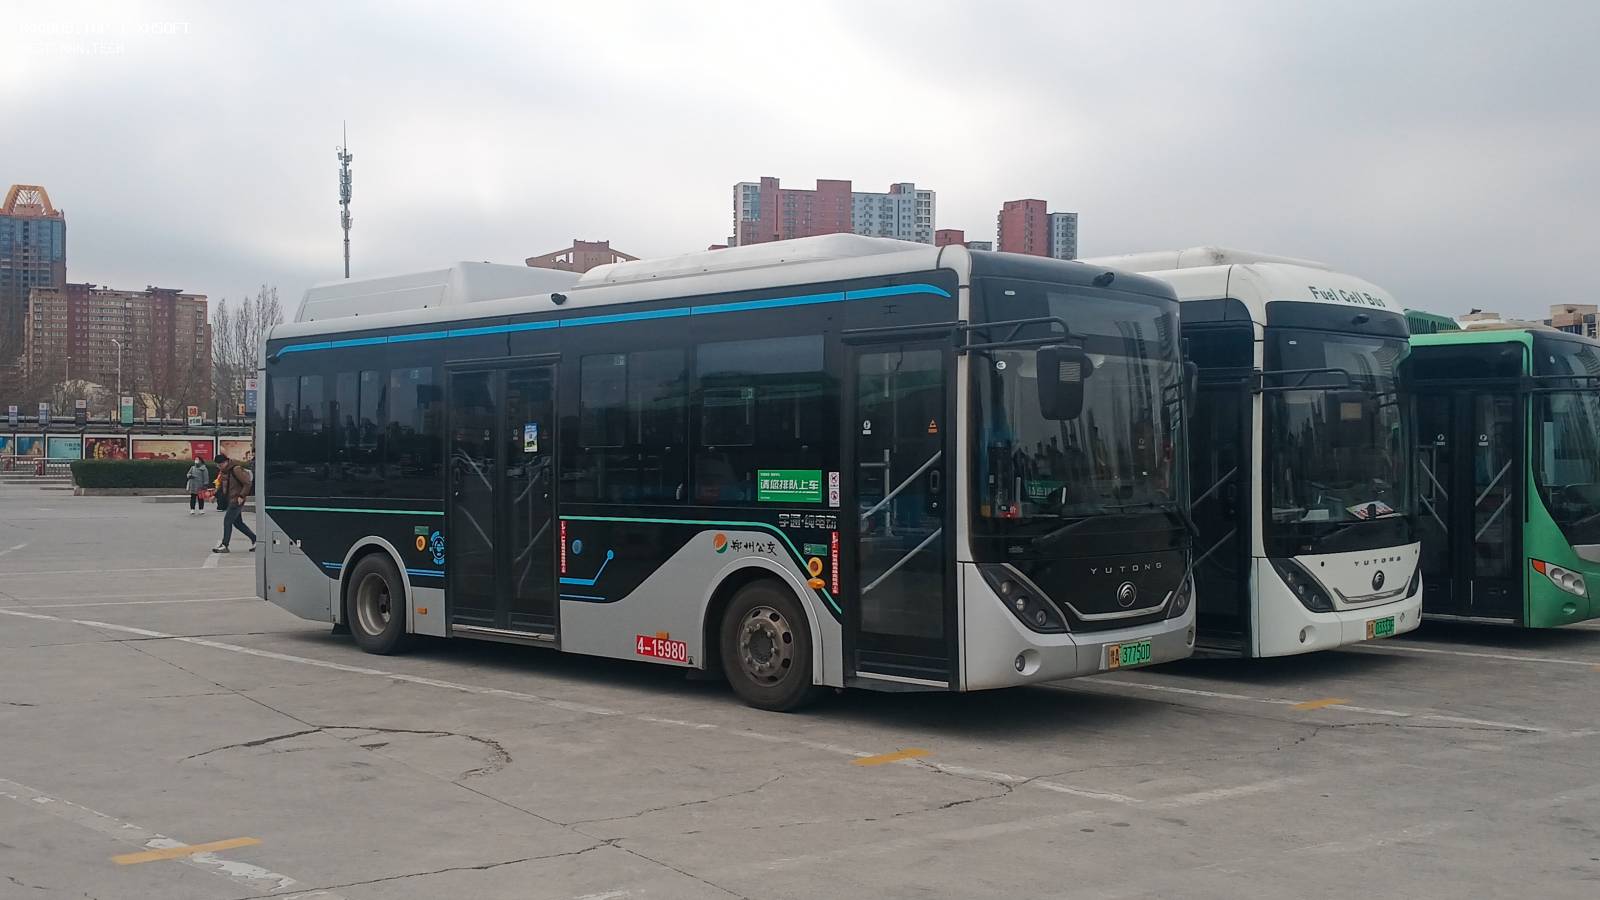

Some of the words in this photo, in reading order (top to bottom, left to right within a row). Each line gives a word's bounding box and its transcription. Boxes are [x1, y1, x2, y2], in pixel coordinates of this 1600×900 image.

[1308, 286, 1339, 301] Fuel
[1339, 289, 1365, 304] Cell
[1363, 293, 1386, 307] Bus
[760, 479, 819, 490] 请您排队上车
[730, 539, 777, 556] 郑州公交
[1090, 562, 1162, 575] YUTONG
[637, 637, 686, 661] 4-15980
